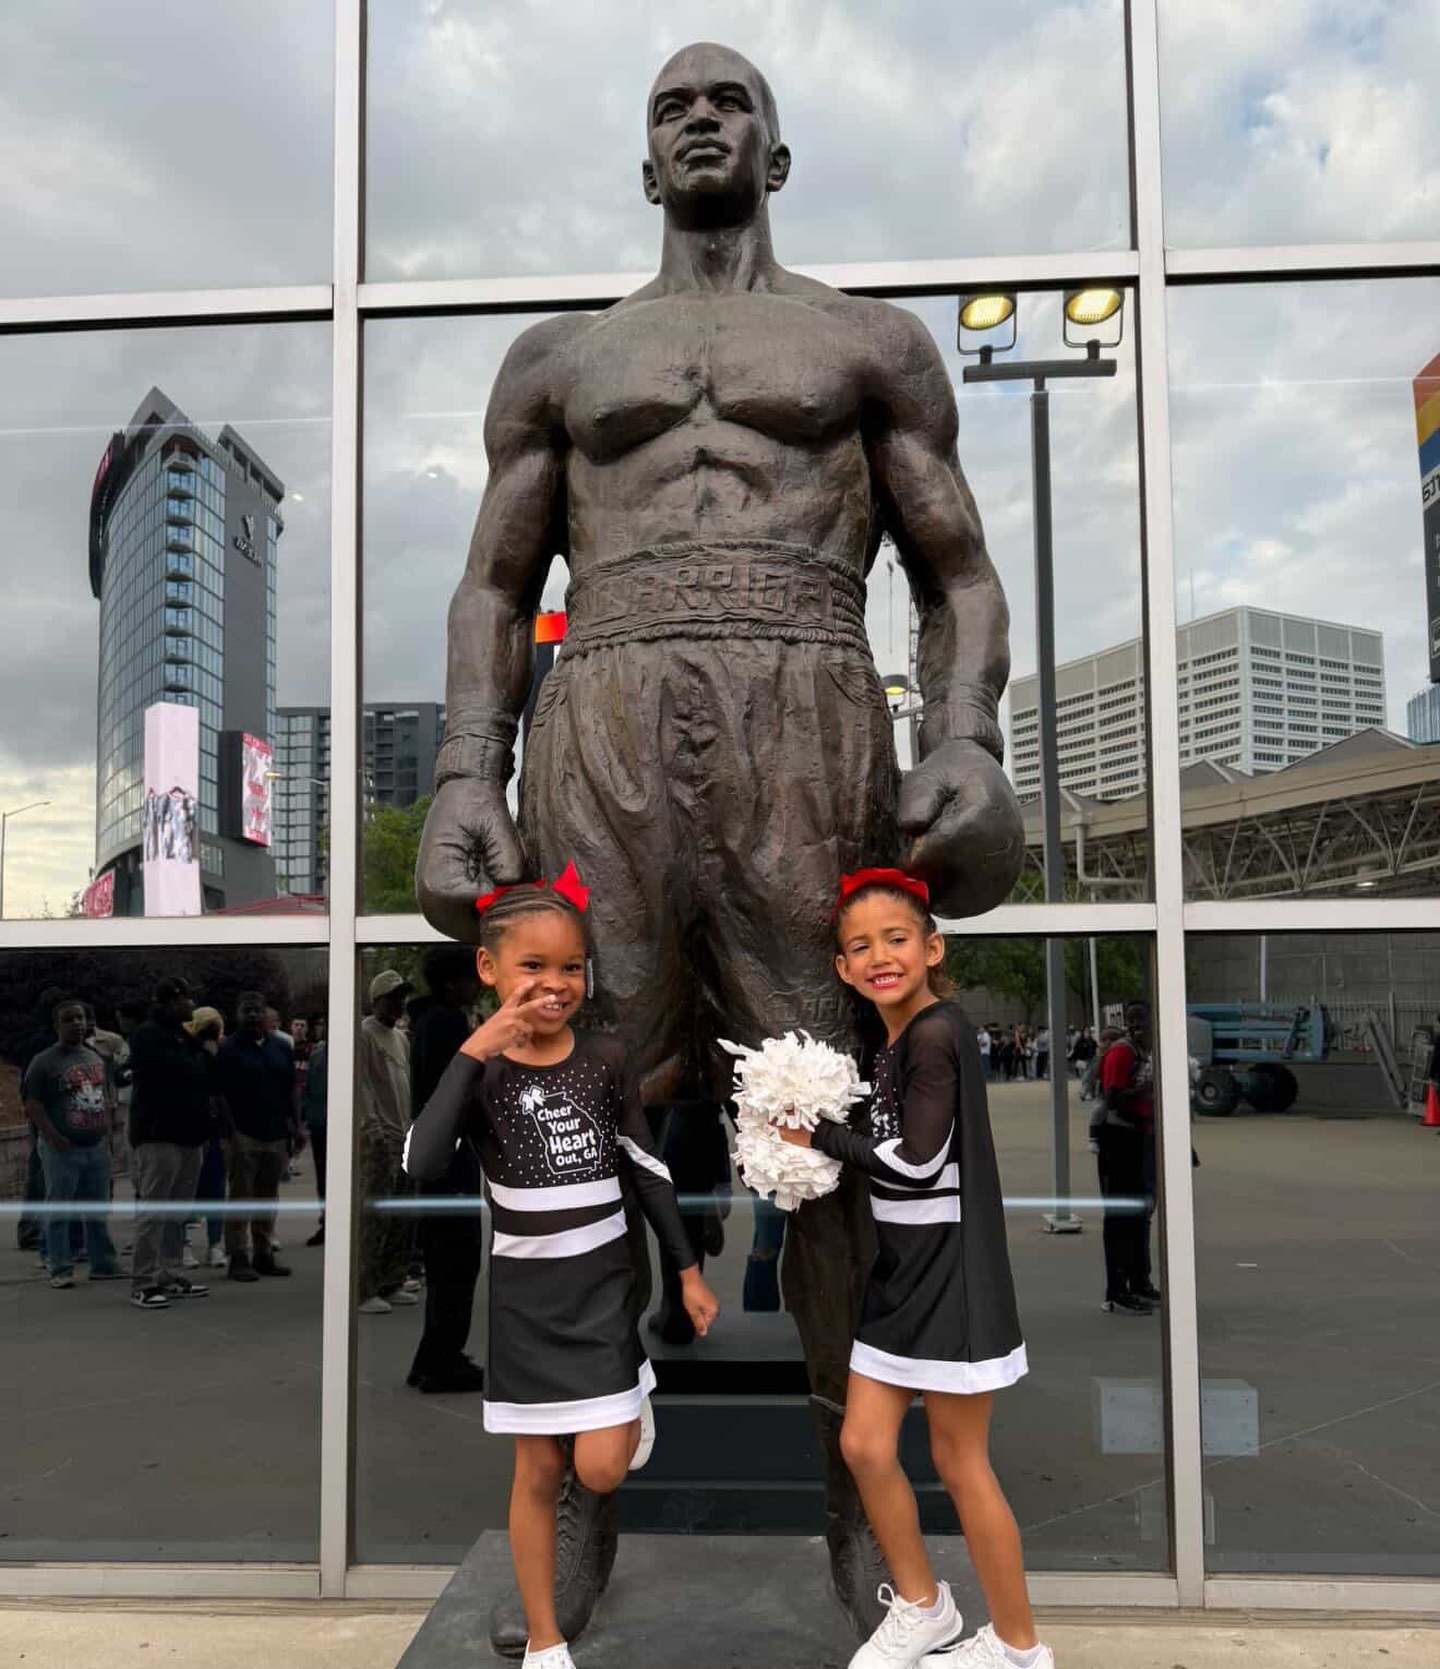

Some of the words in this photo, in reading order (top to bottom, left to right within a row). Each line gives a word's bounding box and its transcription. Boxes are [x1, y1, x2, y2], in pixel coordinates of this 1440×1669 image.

[537, 1105, 573, 1121] Cheer
[547, 1118, 581, 1135] Your
[549, 1128, 596, 1154] Heart
[556, 1153, 582, 1166] Out,
[583, 1147, 598, 1160] GA
